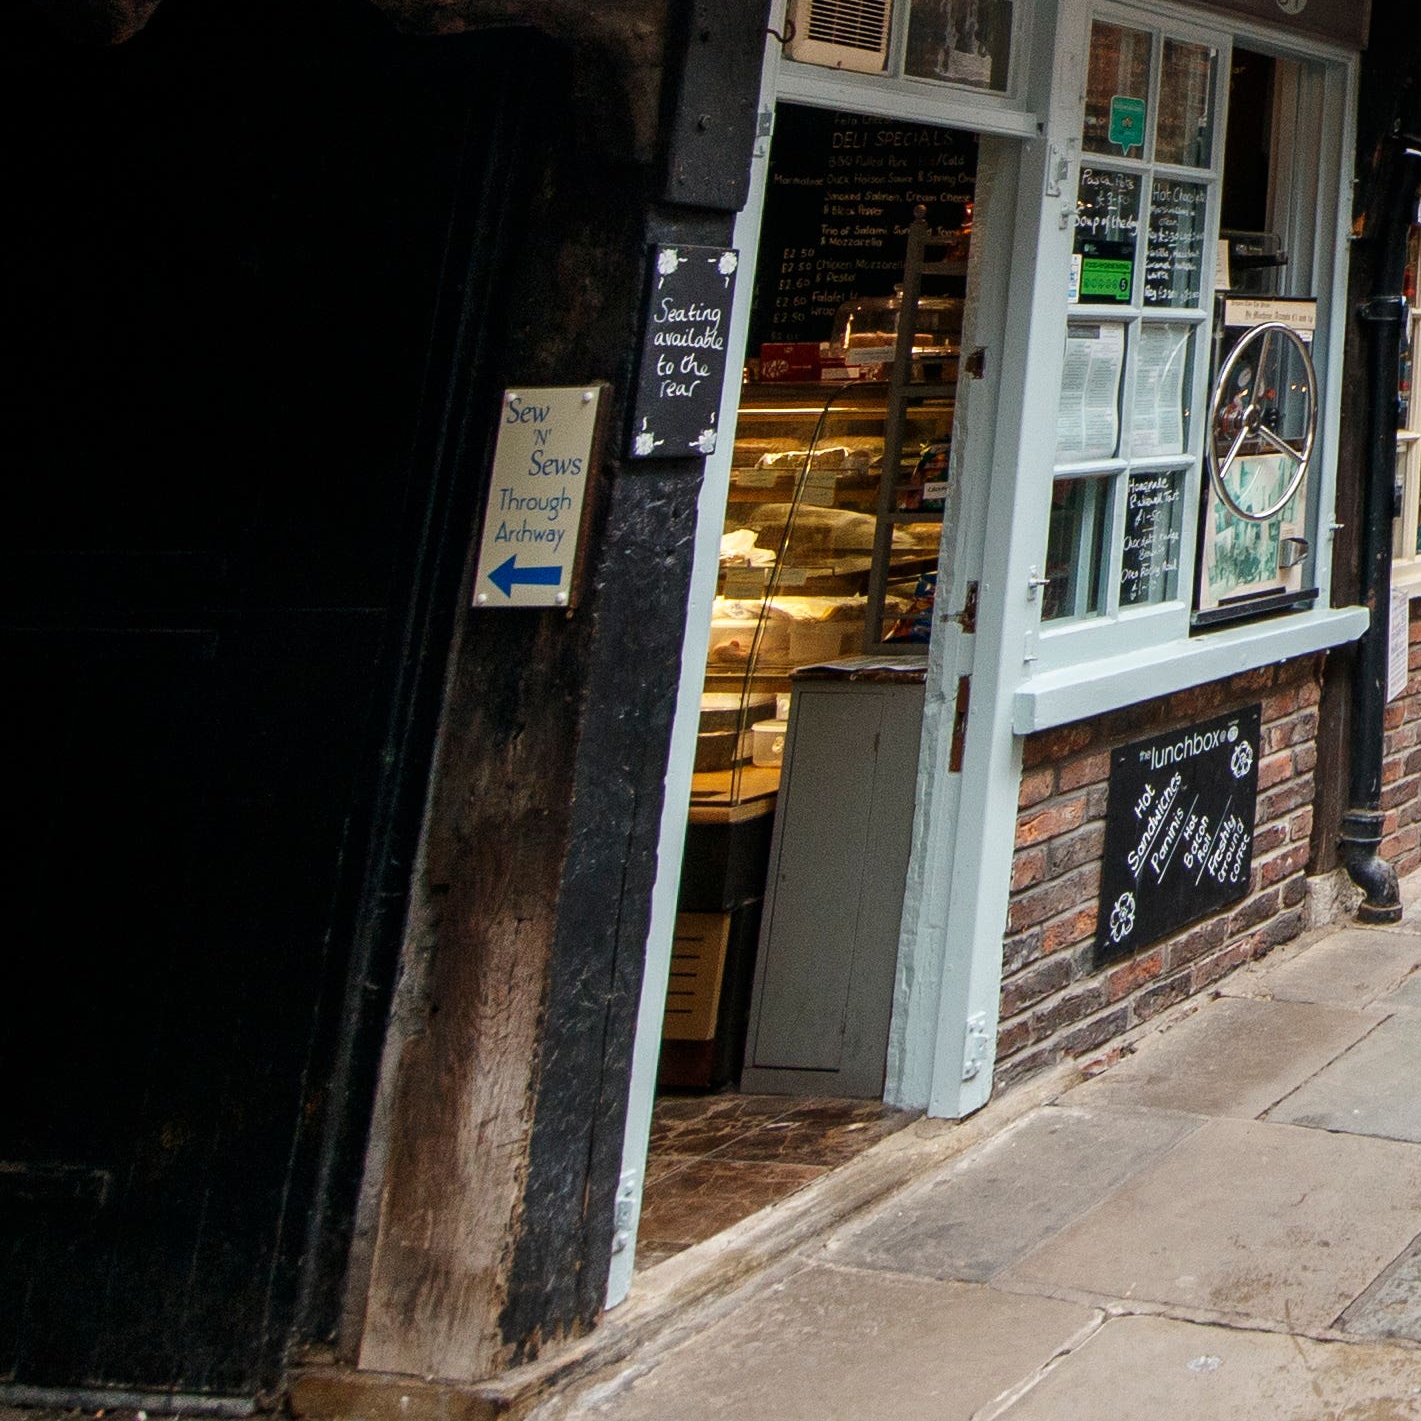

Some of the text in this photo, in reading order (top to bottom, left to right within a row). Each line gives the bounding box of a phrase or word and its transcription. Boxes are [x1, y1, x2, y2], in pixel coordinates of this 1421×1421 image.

[832, 131, 954, 149] DELI SPECIALS
[654, 297, 721, 328] Seating
[654, 327, 724, 350] available
[657, 353, 711, 376] to the
[660, 380, 701, 397] rear
[507, 398, 550, 423] Sew
[534, 429, 552, 446] 'N'
[529, 450, 582, 476] Sews
[500, 487, 571, 521] Through
[495, 519, 565, 553] Archway
[1139, 750, 1151, 763] the
[1150, 730, 1220, 770] lunchbox
[1134, 783, 1156, 819] Hot
[1127, 772, 1182, 871] Sandwiches
[1184, 814, 1198, 841] Hot
[1151, 807, 1184, 874] Paninis
[1184, 815, 1209, 868] Bacon
[1197, 834, 1211, 863] Roll
[1208, 814, 1236, 877] Freshly
